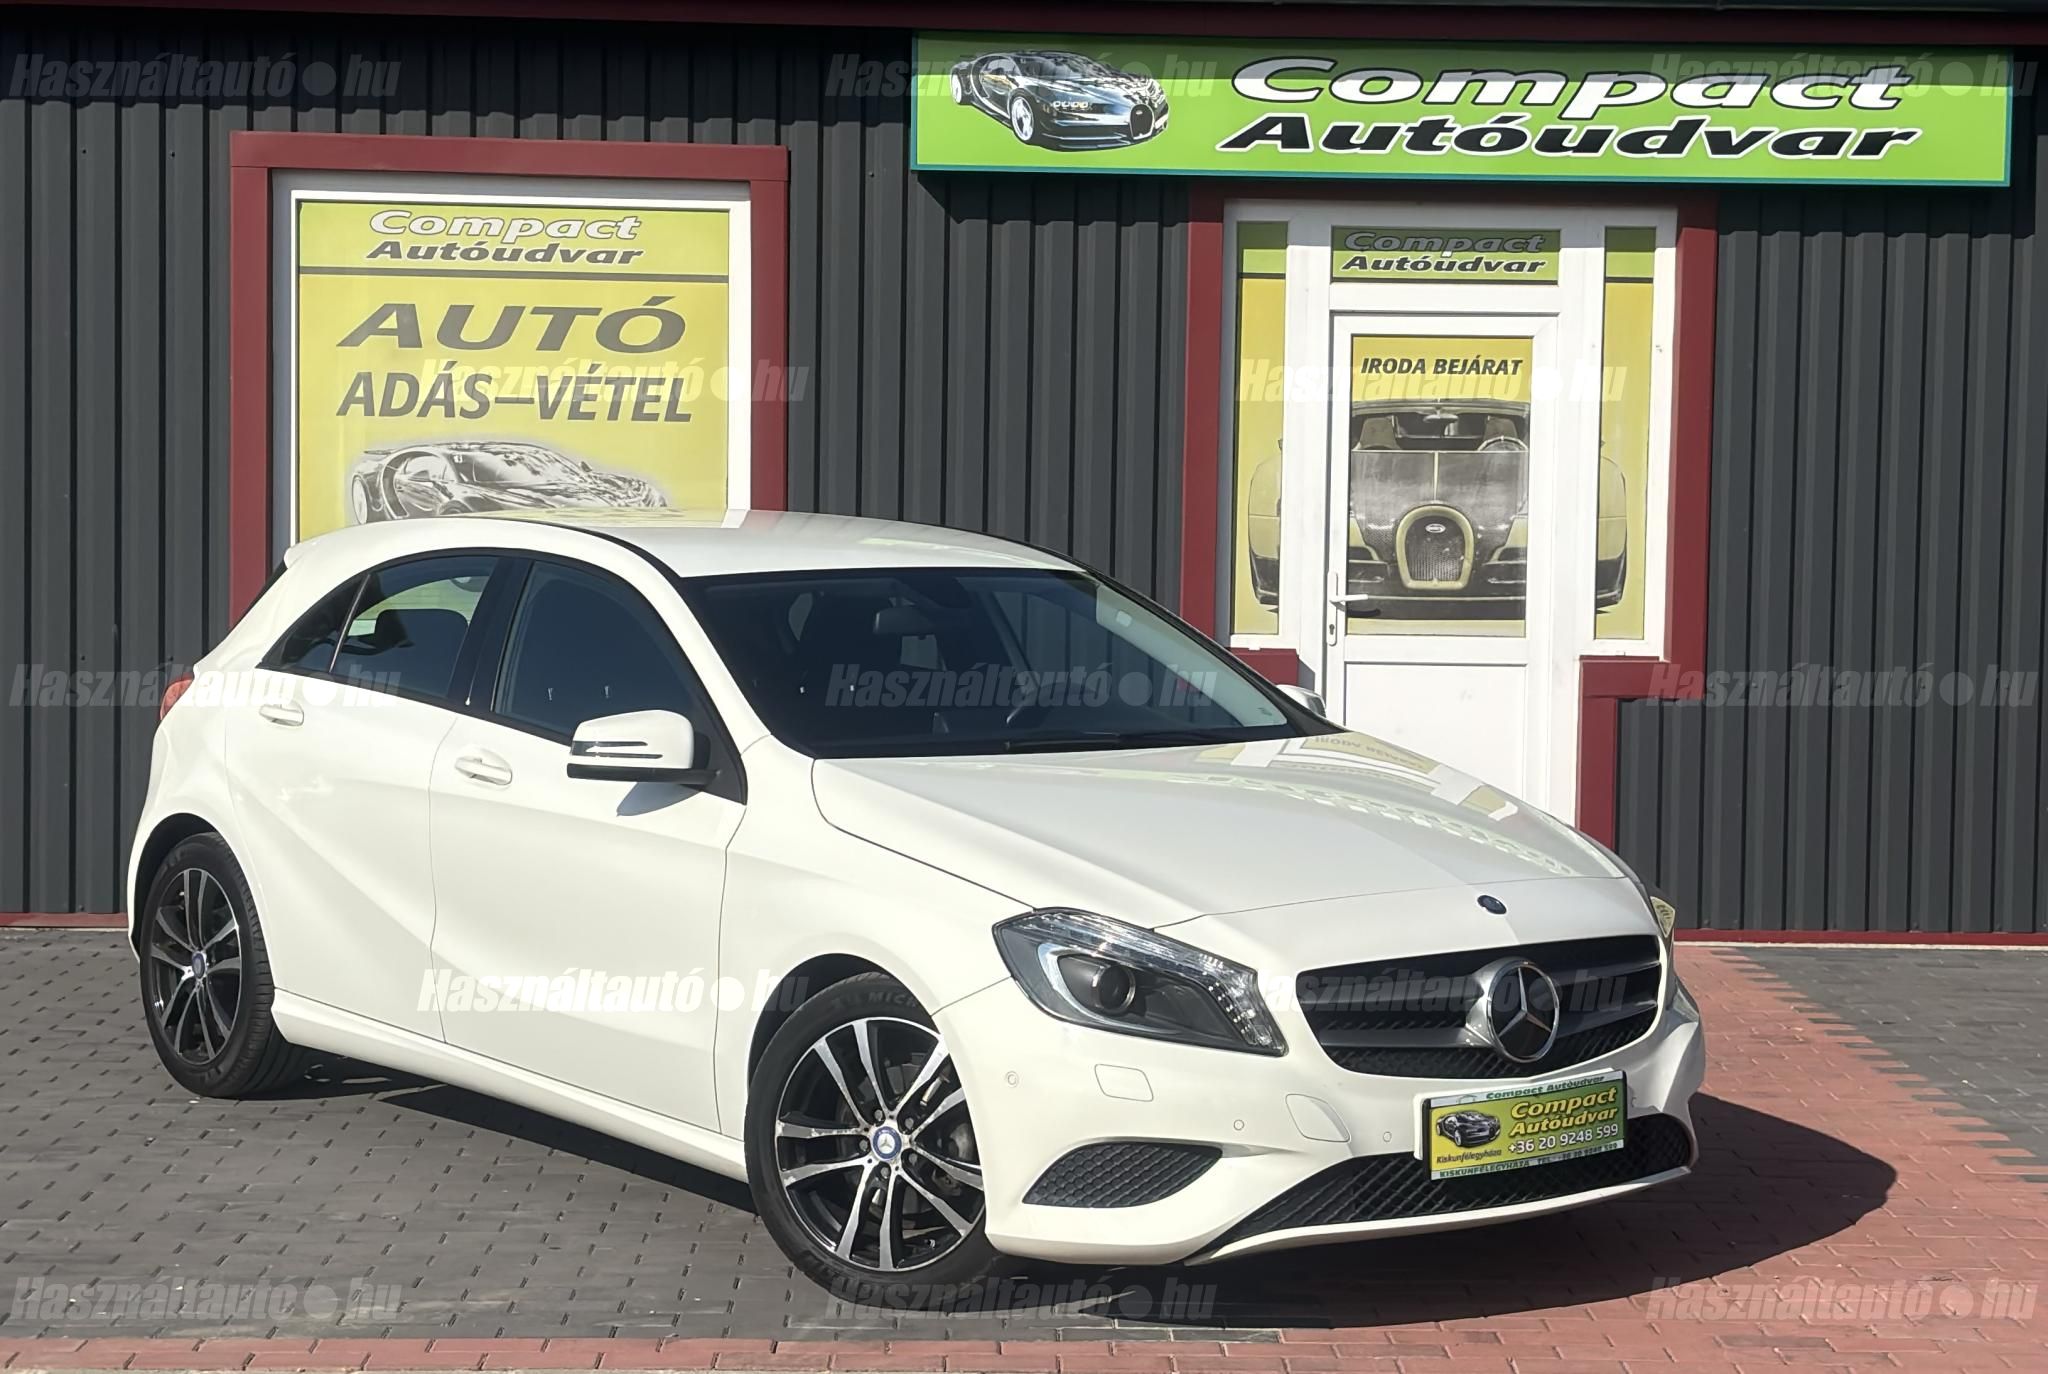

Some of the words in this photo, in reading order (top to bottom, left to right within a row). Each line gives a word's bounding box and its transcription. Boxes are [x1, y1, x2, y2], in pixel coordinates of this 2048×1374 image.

[1228, 54, 1914, 119] Compact
[1215, 113, 1919, 160] Autóudvar
[368, 209, 643, 247] Compact
[1343, 230, 1546, 257] Compact
[366, 240, 645, 266] Autóudvar
[1341, 252, 1546, 274] Autóudvar
[336, 296, 686, 353] AUTÓ
[1360, 357, 1427, 375] IRODA
[1432, 353, 1523, 376] BEJÁRAT
[1486, 1086, 1544, 1099] Compact
[1511, 1087, 1617, 1120] Compact
[1509, 1107, 1618, 1137] Autóudvar
[1508, 1141, 1535, 1155] +36
[1539, 1135, 1556, 1150] 20
[1560, 1129, 1593, 1147] 9248
[1596, 1123, 1618, 1139] 599
